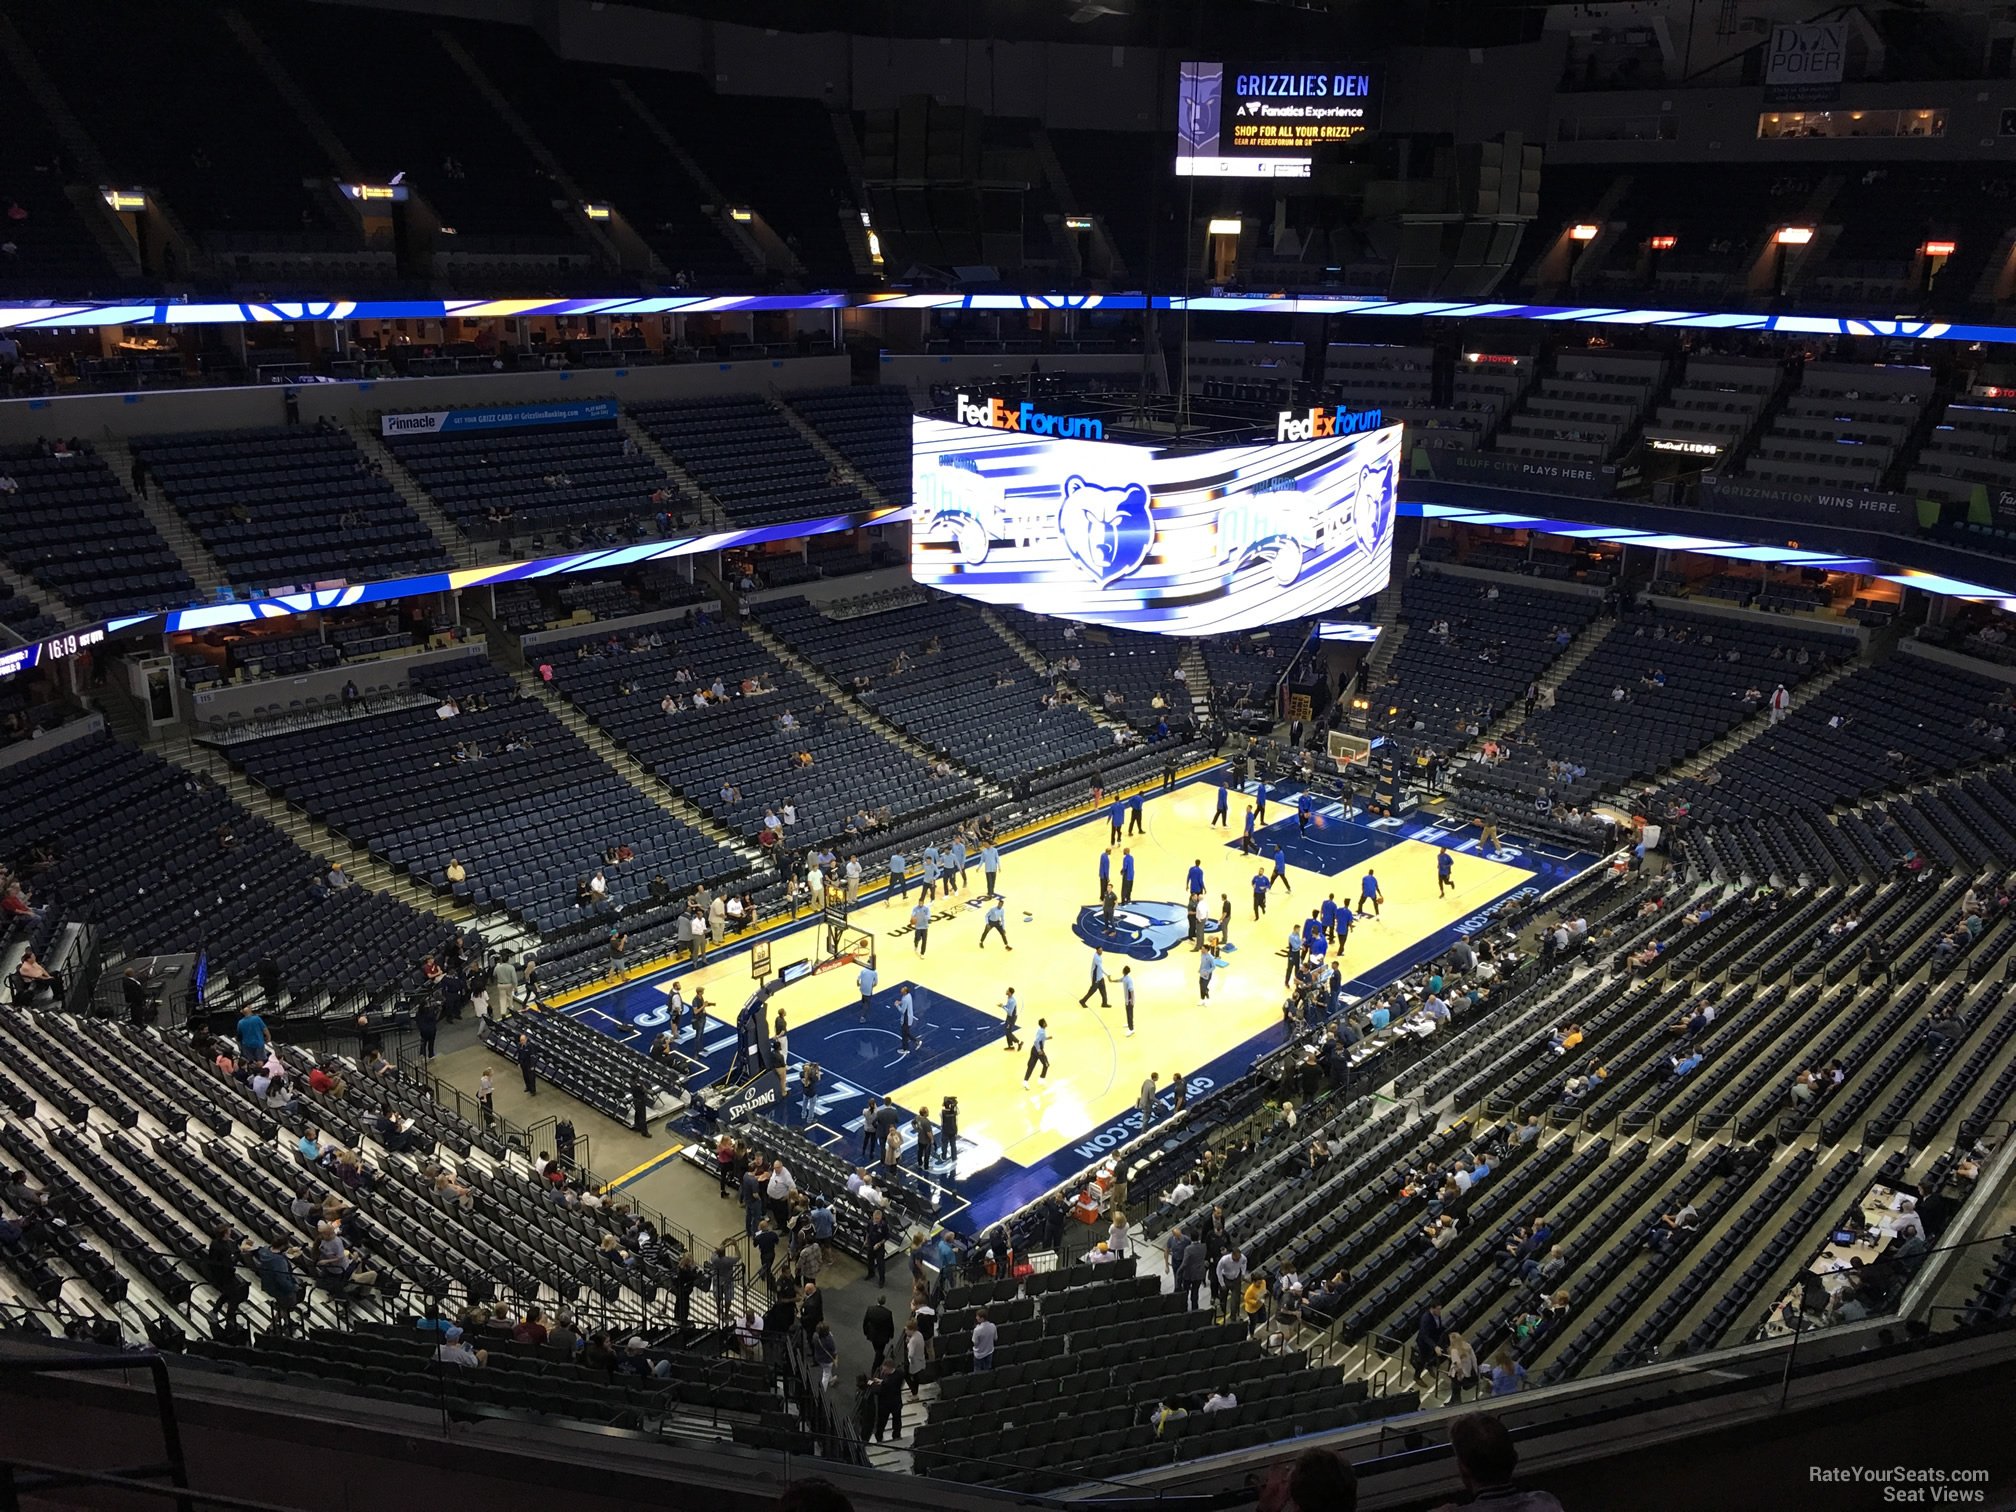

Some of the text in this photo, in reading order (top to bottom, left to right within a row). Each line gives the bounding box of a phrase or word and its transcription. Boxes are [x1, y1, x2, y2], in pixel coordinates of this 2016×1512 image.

[1236, 75, 1369, 96] GRIZZLIES DEN
[1237, 105, 1364, 119] A Fanatics Experience
[1234, 126, 1258, 137] SHOP
[1259, 126, 1277, 137] FOR
[1278, 126, 1294, 137] ALL
[1295, 126, 1318, 138] YOUR
[1257, 138, 1294, 147] FEDEXFORUM
[1295, 138, 1303, 146] OR
[388, 415, 435, 430] Pinnacle
[478, 414, 496, 423] GRIZZ
[497, 413, 512, 421] CARD
[957, 394, 1102, 439] FedExForum
[1278, 405, 1381, 442] FedExForum
[1653, 441, 1717, 455] FanDuel LEDGE
[1456, 456, 1490, 470] BLUFF
[1494, 461, 1519, 471] CITY
[1522, 464, 1558, 477] PLAYS
[1562, 468, 1596, 481] HERE.
[1713, 484, 1901, 514] #GRIZZNATION WINS HERE.
[48, 635, 77, 660] 16:19
[729, 1088, 775, 1122] SPALDING
